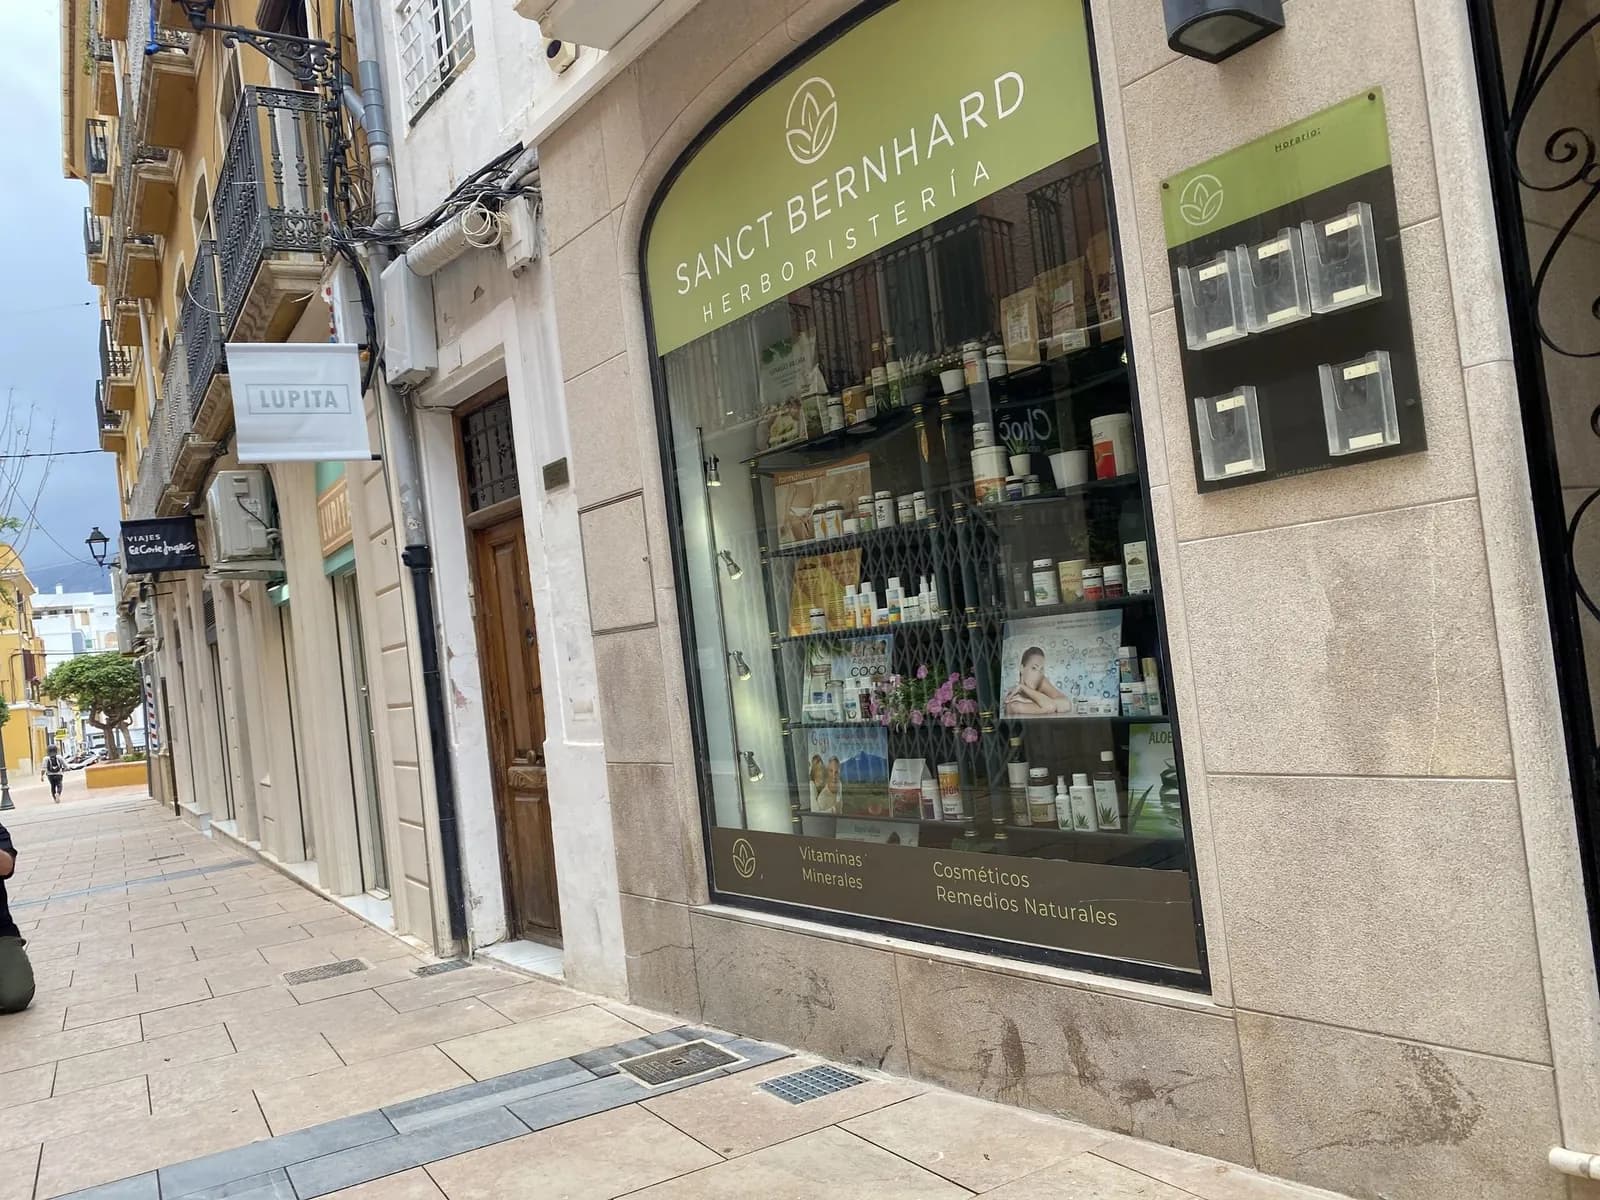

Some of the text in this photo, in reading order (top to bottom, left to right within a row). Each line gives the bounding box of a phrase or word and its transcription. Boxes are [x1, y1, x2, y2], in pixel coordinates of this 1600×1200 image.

[1274, 127, 1321, 153] Horario:
[676, 71, 1026, 296] SANCT BERNHARD
[702, 160, 991, 324] HERBORISTERÍA
[259, 390, 338, 409] LUPITA
[126, 534, 161, 543] VIAJES
[799, 845, 863, 868] Vitaminas
[802, 866, 864, 890] Minerales
[932, 860, 1030, 889] Cosméticos
[936, 884, 1119, 927] Remedios Naturales
